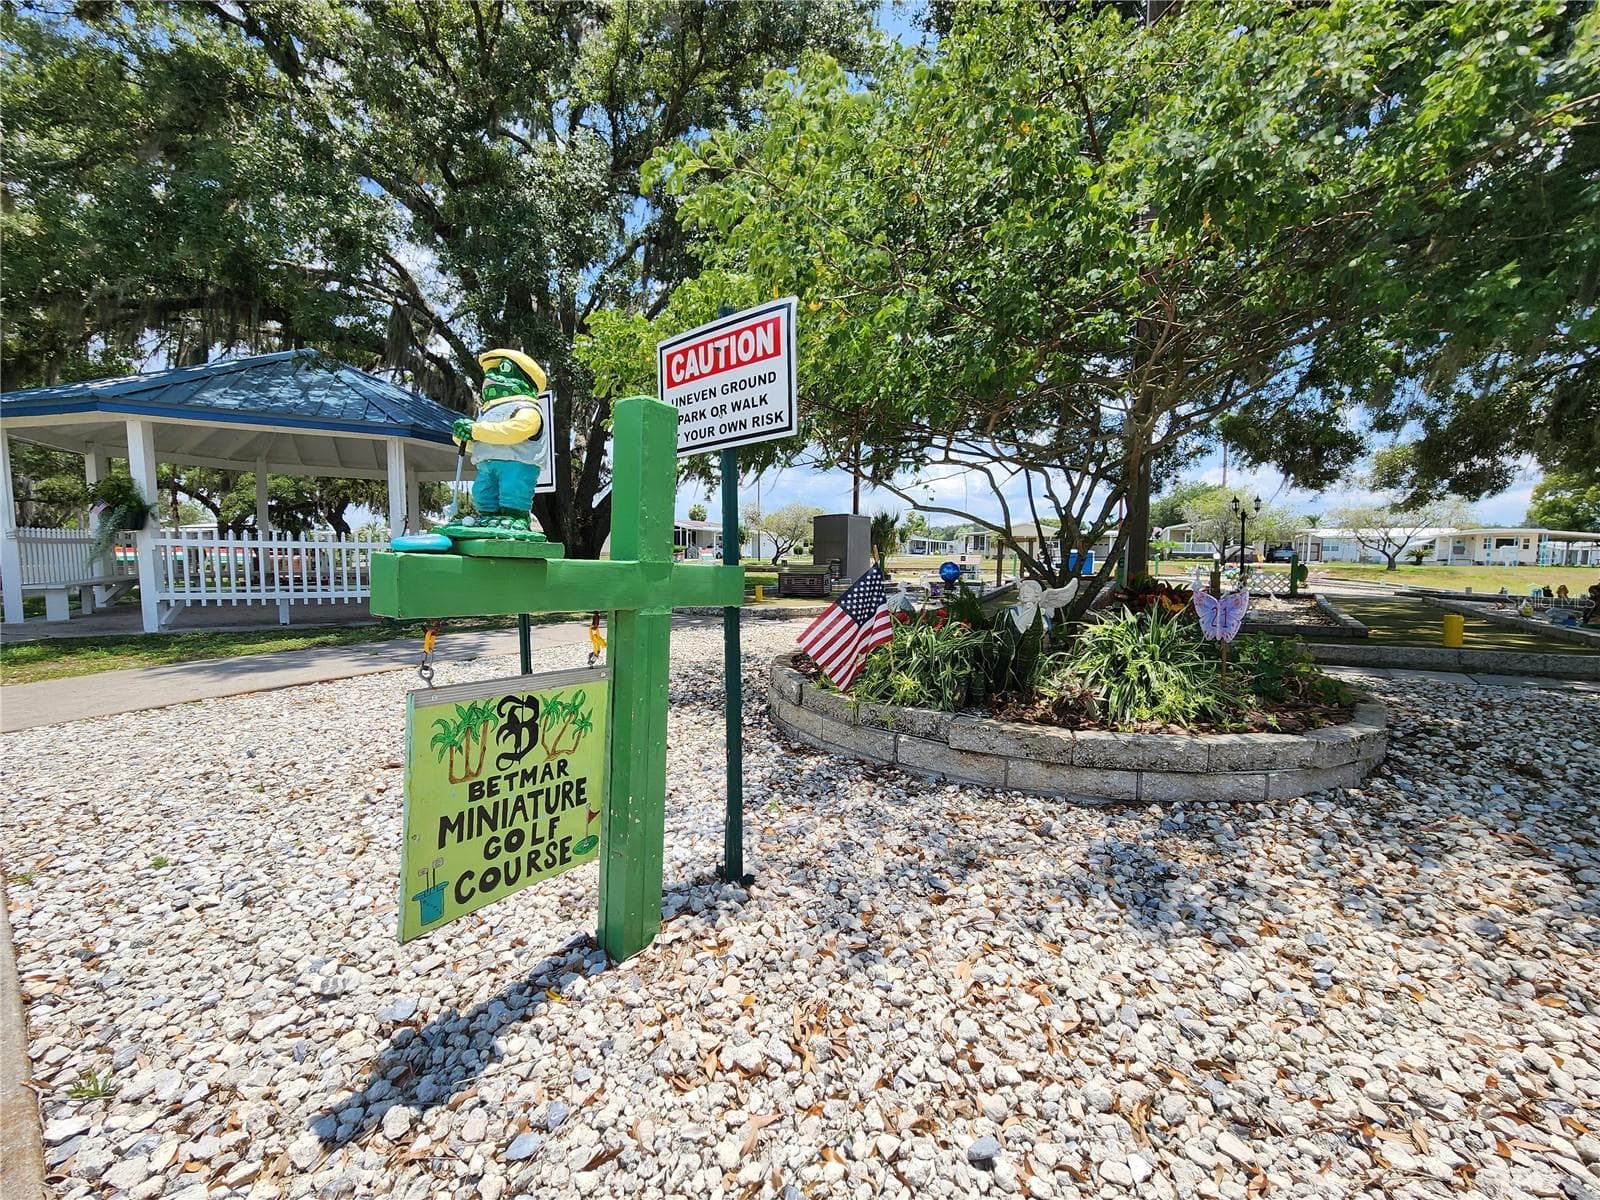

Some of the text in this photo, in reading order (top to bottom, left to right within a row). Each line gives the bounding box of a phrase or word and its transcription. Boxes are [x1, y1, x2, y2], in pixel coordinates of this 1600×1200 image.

[671, 322, 775, 383] CAUTION
[720, 371, 777, 396] GROUND
[678, 393, 769, 425] PARK OR WALK
[684, 410, 785, 442] YOUR OWN RISK
[1211, 606, 1229, 628] 21
[495, 694, 540, 771] B
[468, 758, 570, 803] BETMAR
[438, 777, 588, 850] MINIATURE
[483, 816, 561, 861] GOLF
[454, 836, 573, 905] COURSE
